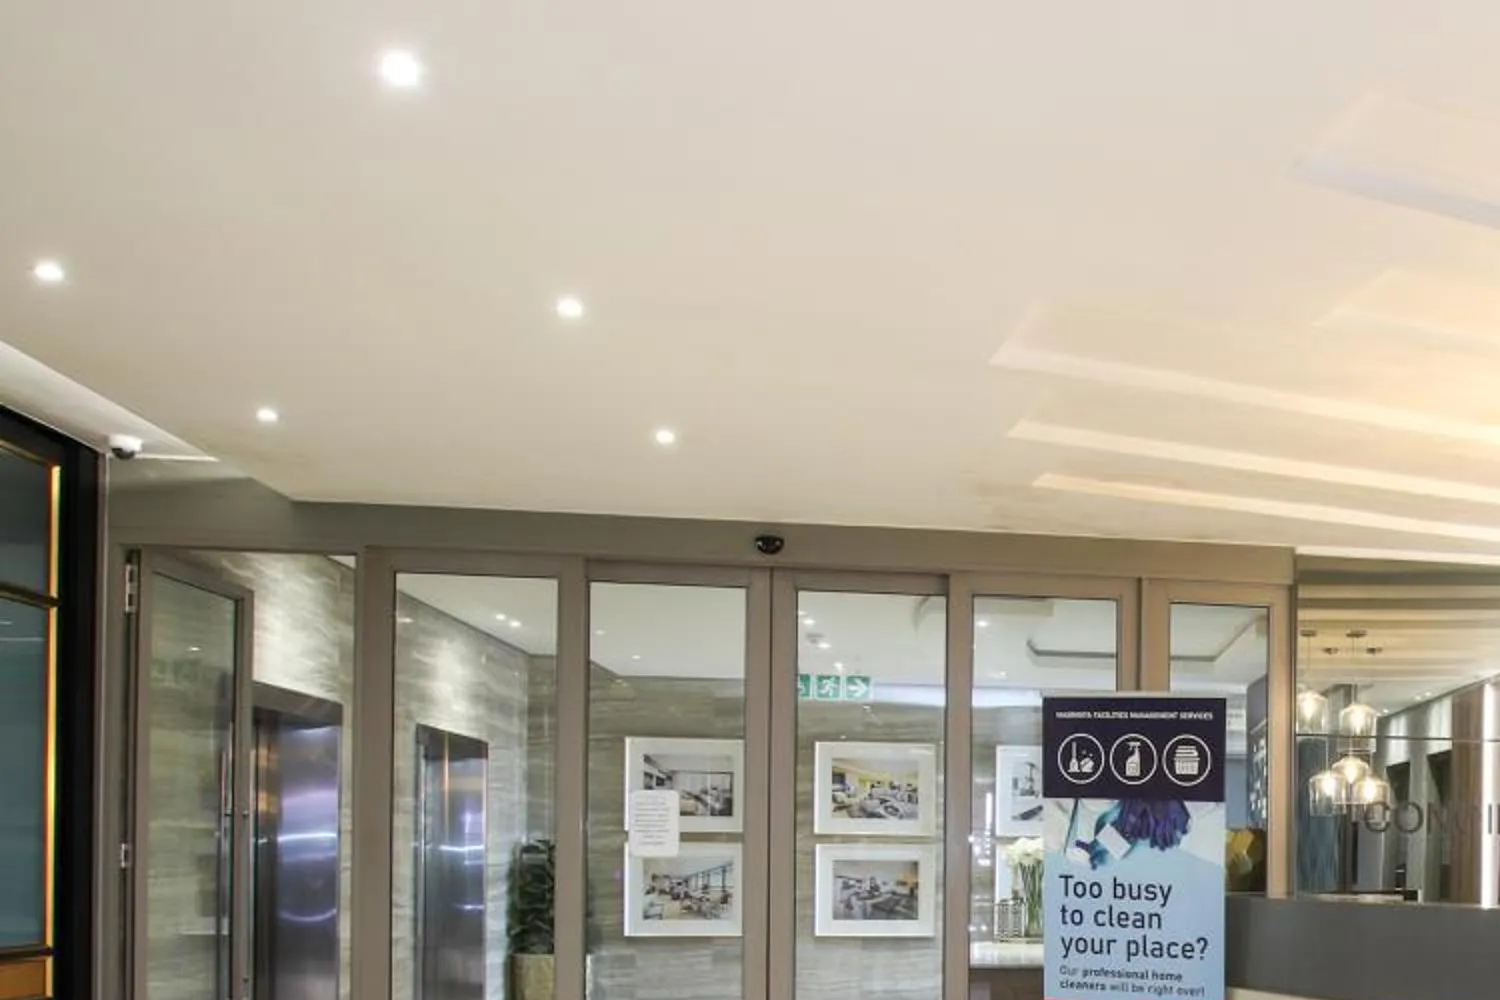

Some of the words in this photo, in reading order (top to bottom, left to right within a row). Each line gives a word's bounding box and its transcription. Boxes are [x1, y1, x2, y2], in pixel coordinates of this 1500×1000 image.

[1059, 874, 1103, 899] Too
[1113, 876, 1172, 908] busy
[1060, 904, 1083, 926] to
[1093, 905, 1162, 929] clean
[1060, 936, 1117, 959] your
[1126, 934, 1209, 962] place?
[1059, 965, 1079, 977] Our
[1082, 967, 1149, 980] professional
[1151, 969, 1183, 982] home
[1059, 979, 1107, 991] cleaners
[1109, 982, 1129, 993] will
[1131, 983, 1145, 993] be
[1147, 984, 1174, 997] right
